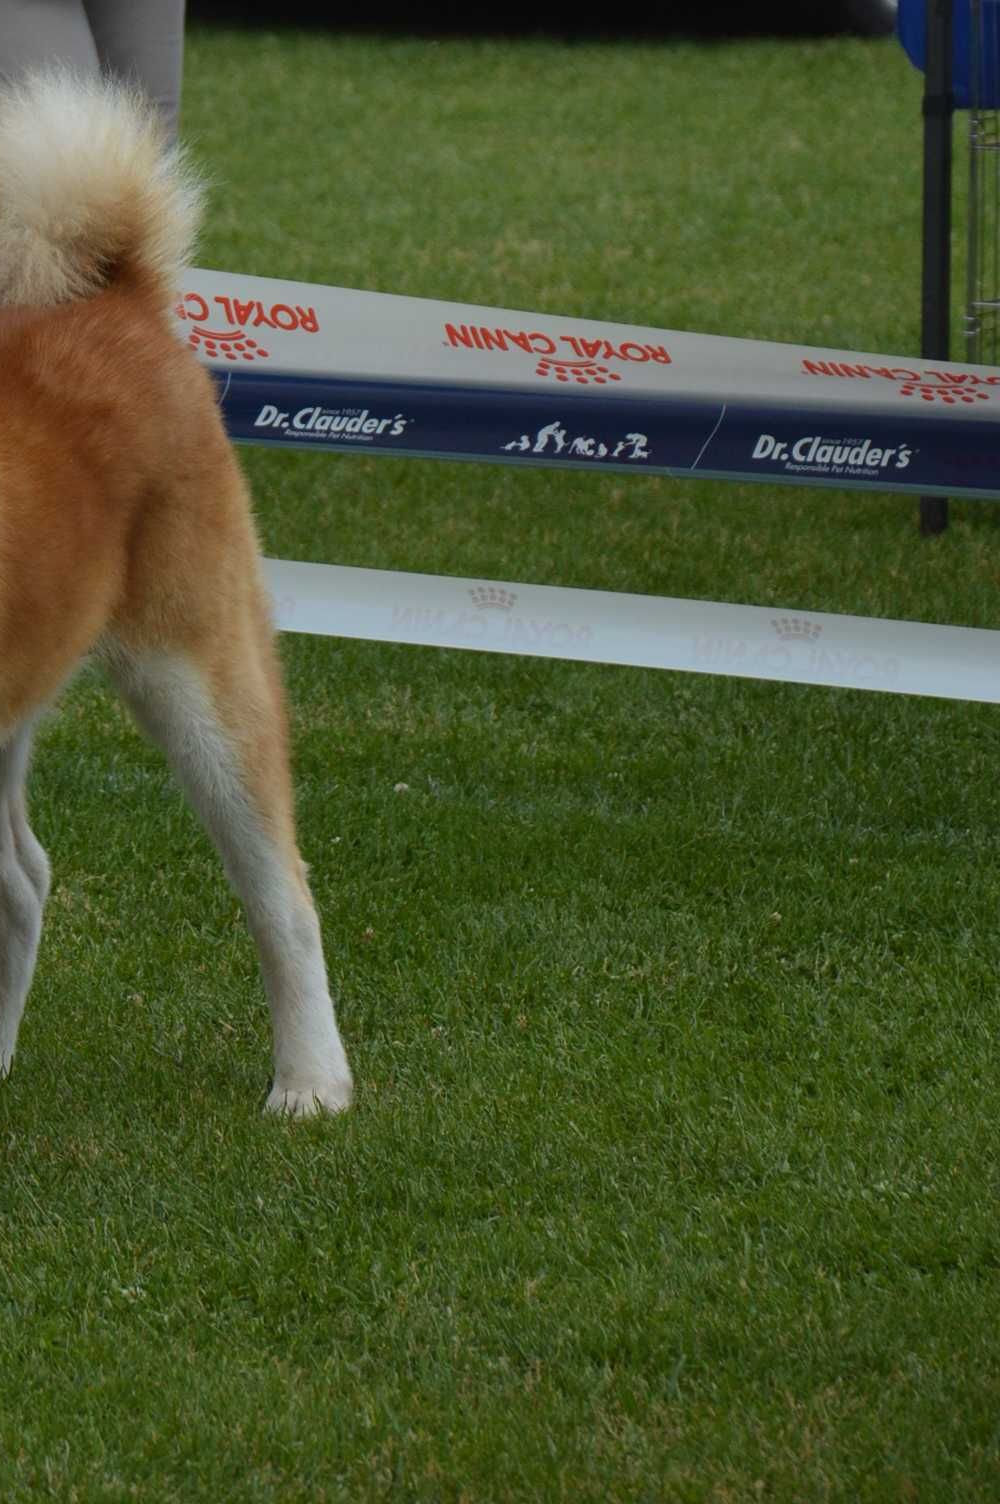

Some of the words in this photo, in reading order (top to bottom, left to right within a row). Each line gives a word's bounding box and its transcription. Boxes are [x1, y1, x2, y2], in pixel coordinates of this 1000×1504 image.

[213, 295, 320, 333] ROYAL
[444, 323, 557, 356] CANIN
[560, 334, 672, 365] ROYAL
[802, 359, 921, 383] CANIN
